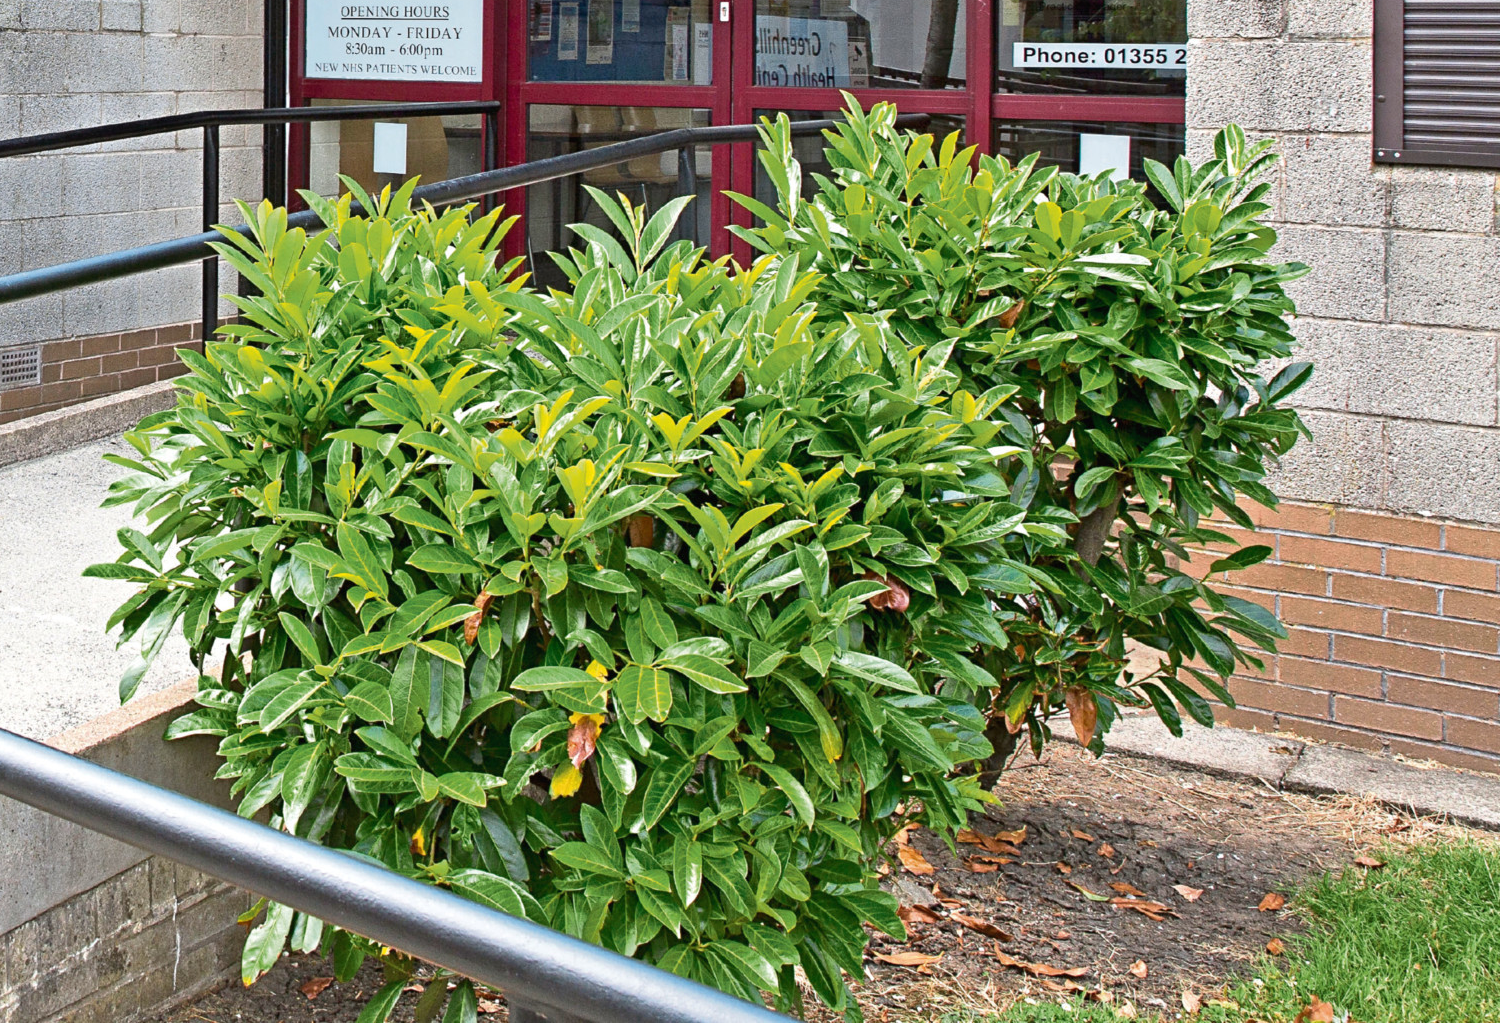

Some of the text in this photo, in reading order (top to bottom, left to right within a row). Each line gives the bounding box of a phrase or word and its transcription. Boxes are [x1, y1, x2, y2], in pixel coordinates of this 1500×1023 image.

[341, 6, 449, 18] OPENING HOURS
[328, 26, 392, 39] MONDAY
[407, 27, 463, 39] FRIDAY
[346, 43, 385, 55] 8:30am
[399, 44, 443, 59] 6:00pm
[1023, 47, 1095, 63] Phone:
[1104, 48, 1166, 64] 01355
[315, 63, 477, 75] NEW NHS PATIENTS WELCOME
